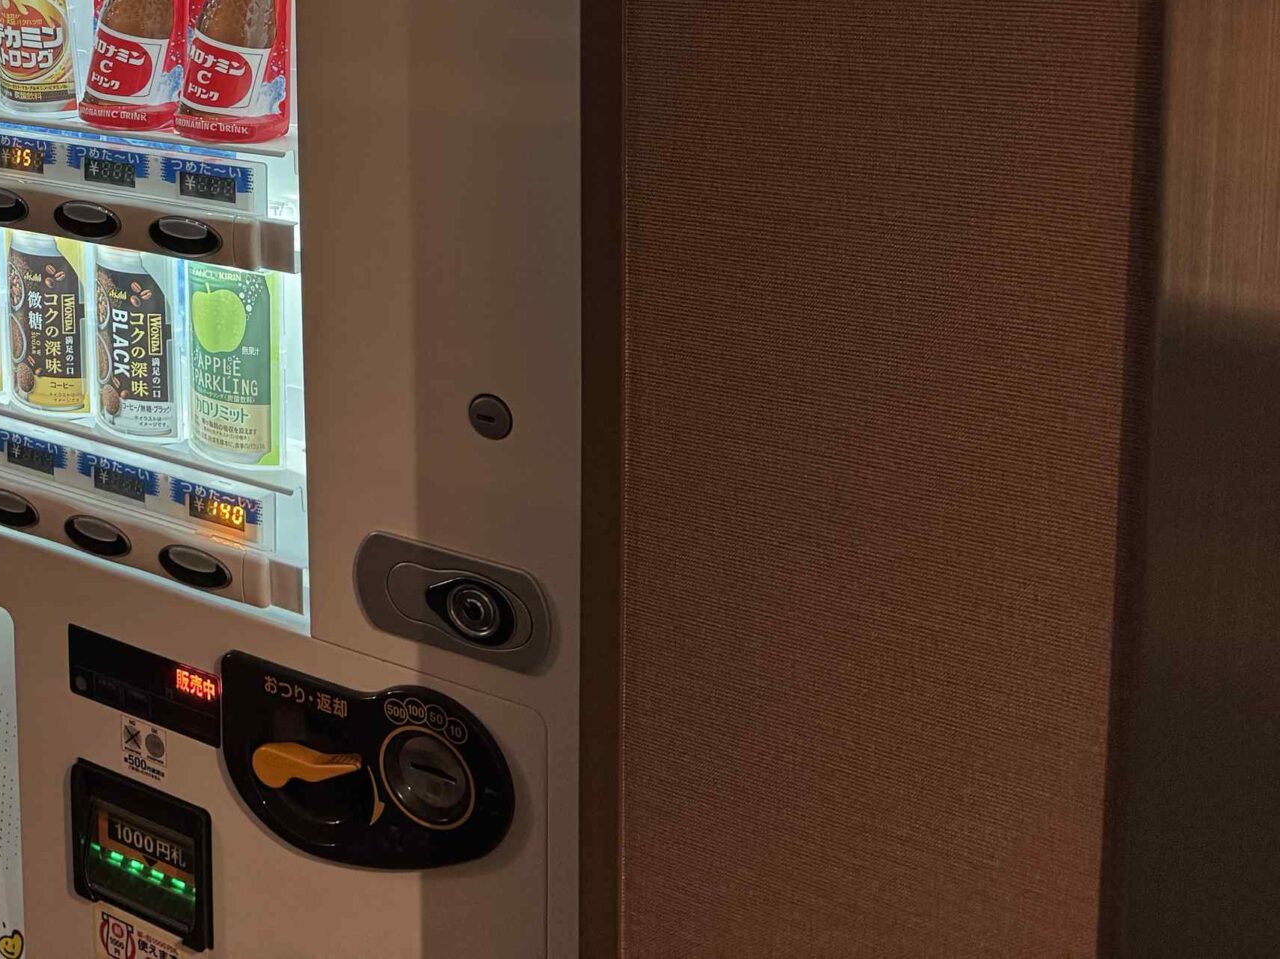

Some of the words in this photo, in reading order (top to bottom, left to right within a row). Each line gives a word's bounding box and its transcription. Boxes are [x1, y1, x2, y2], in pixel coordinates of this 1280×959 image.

[99, 60, 113, 73] C
[91, 74, 120, 90] ドリンク
[197, 70, 212, 84] C
[188, 83, 220, 101] ドリンク
[119, 111, 147, 121] DRINK
[219, 123, 249, 134] DRINK
[219, 272, 242, 281] KIRIN
[28, 290, 42, 330] 微糖
[44, 293, 62, 375] コクの深味
[149, 316, 161, 353] WONDA
[111, 309, 130, 378] BLACK
[129, 312, 149, 397] コクの深味
[194, 371, 258, 396] PARKLING
[176, 669, 215, 700] 販売中
[264, 675, 348, 718] おつり・返却
[387, 704, 405, 719] 500
[408, 704, 424, 718] 100
[430, 714, 443, 725] 50
[450, 726, 462, 738] 10
[114, 824, 186, 867] 1000円札
